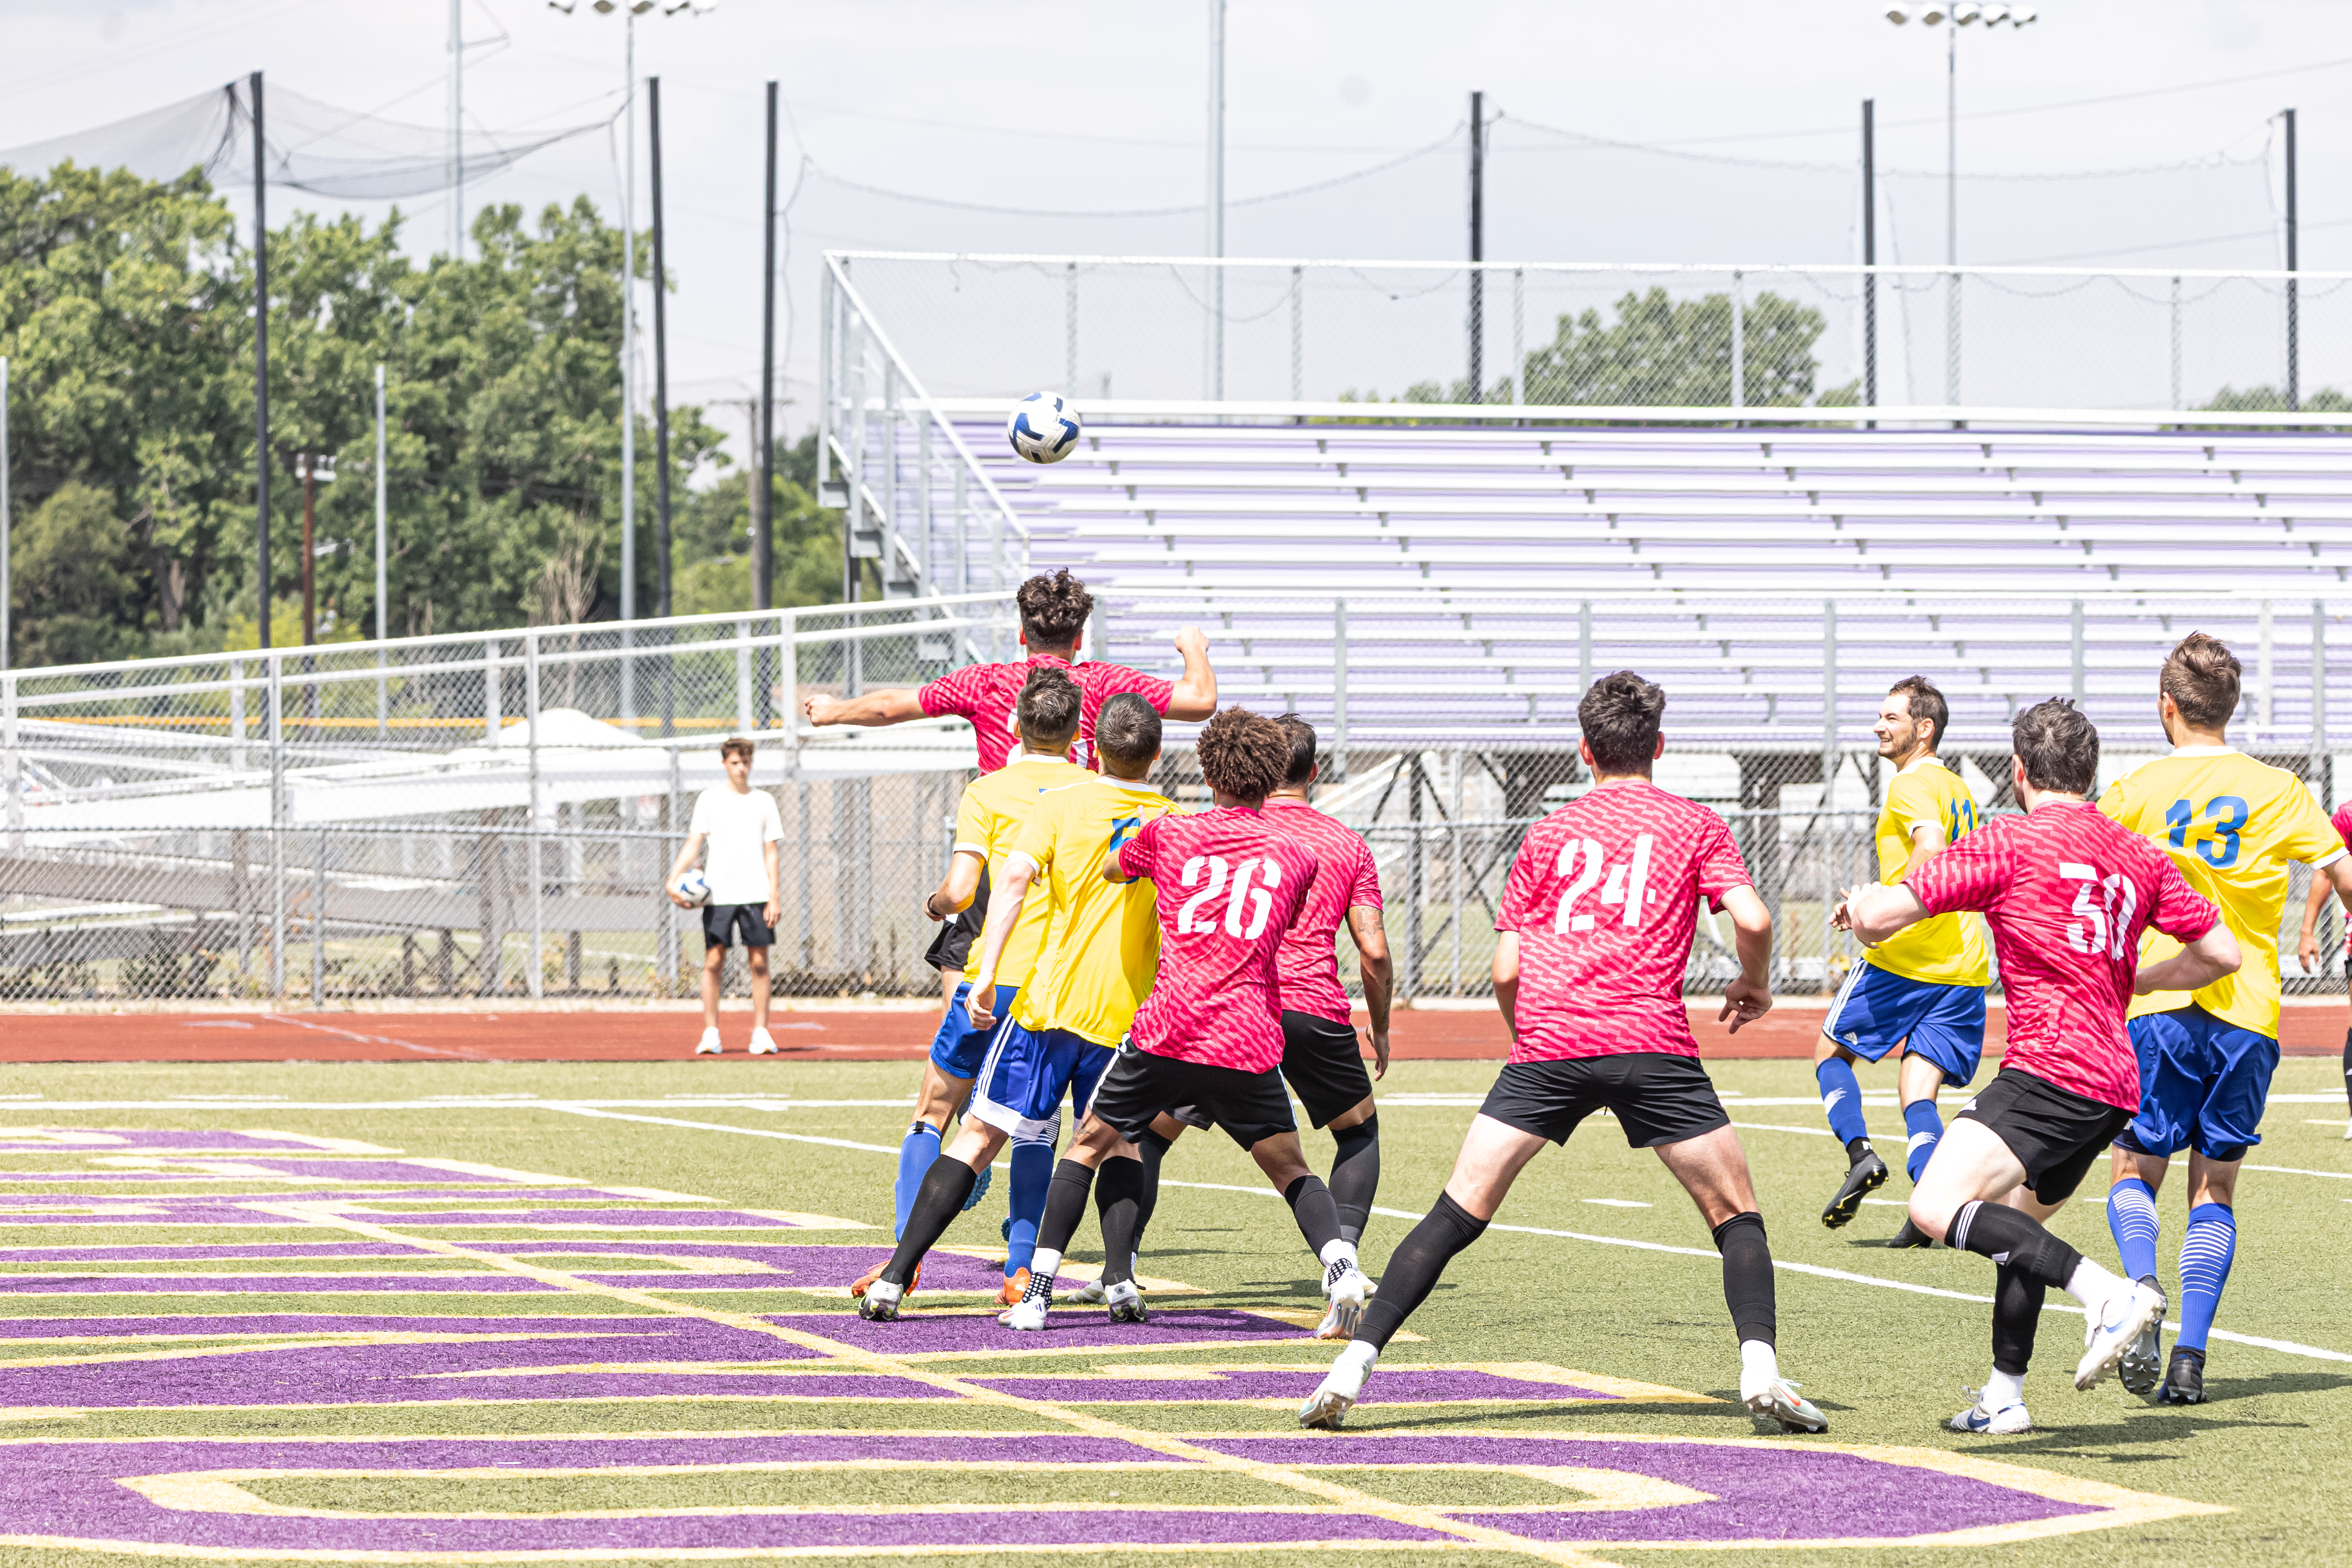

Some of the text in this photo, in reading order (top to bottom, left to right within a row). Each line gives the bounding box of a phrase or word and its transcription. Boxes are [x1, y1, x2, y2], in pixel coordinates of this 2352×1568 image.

[1950, 797, 1973, 844] 11
[2165, 796, 2249, 869] 13
[1178, 855, 1282, 940] 26
[1555, 835, 1656, 935] 24
